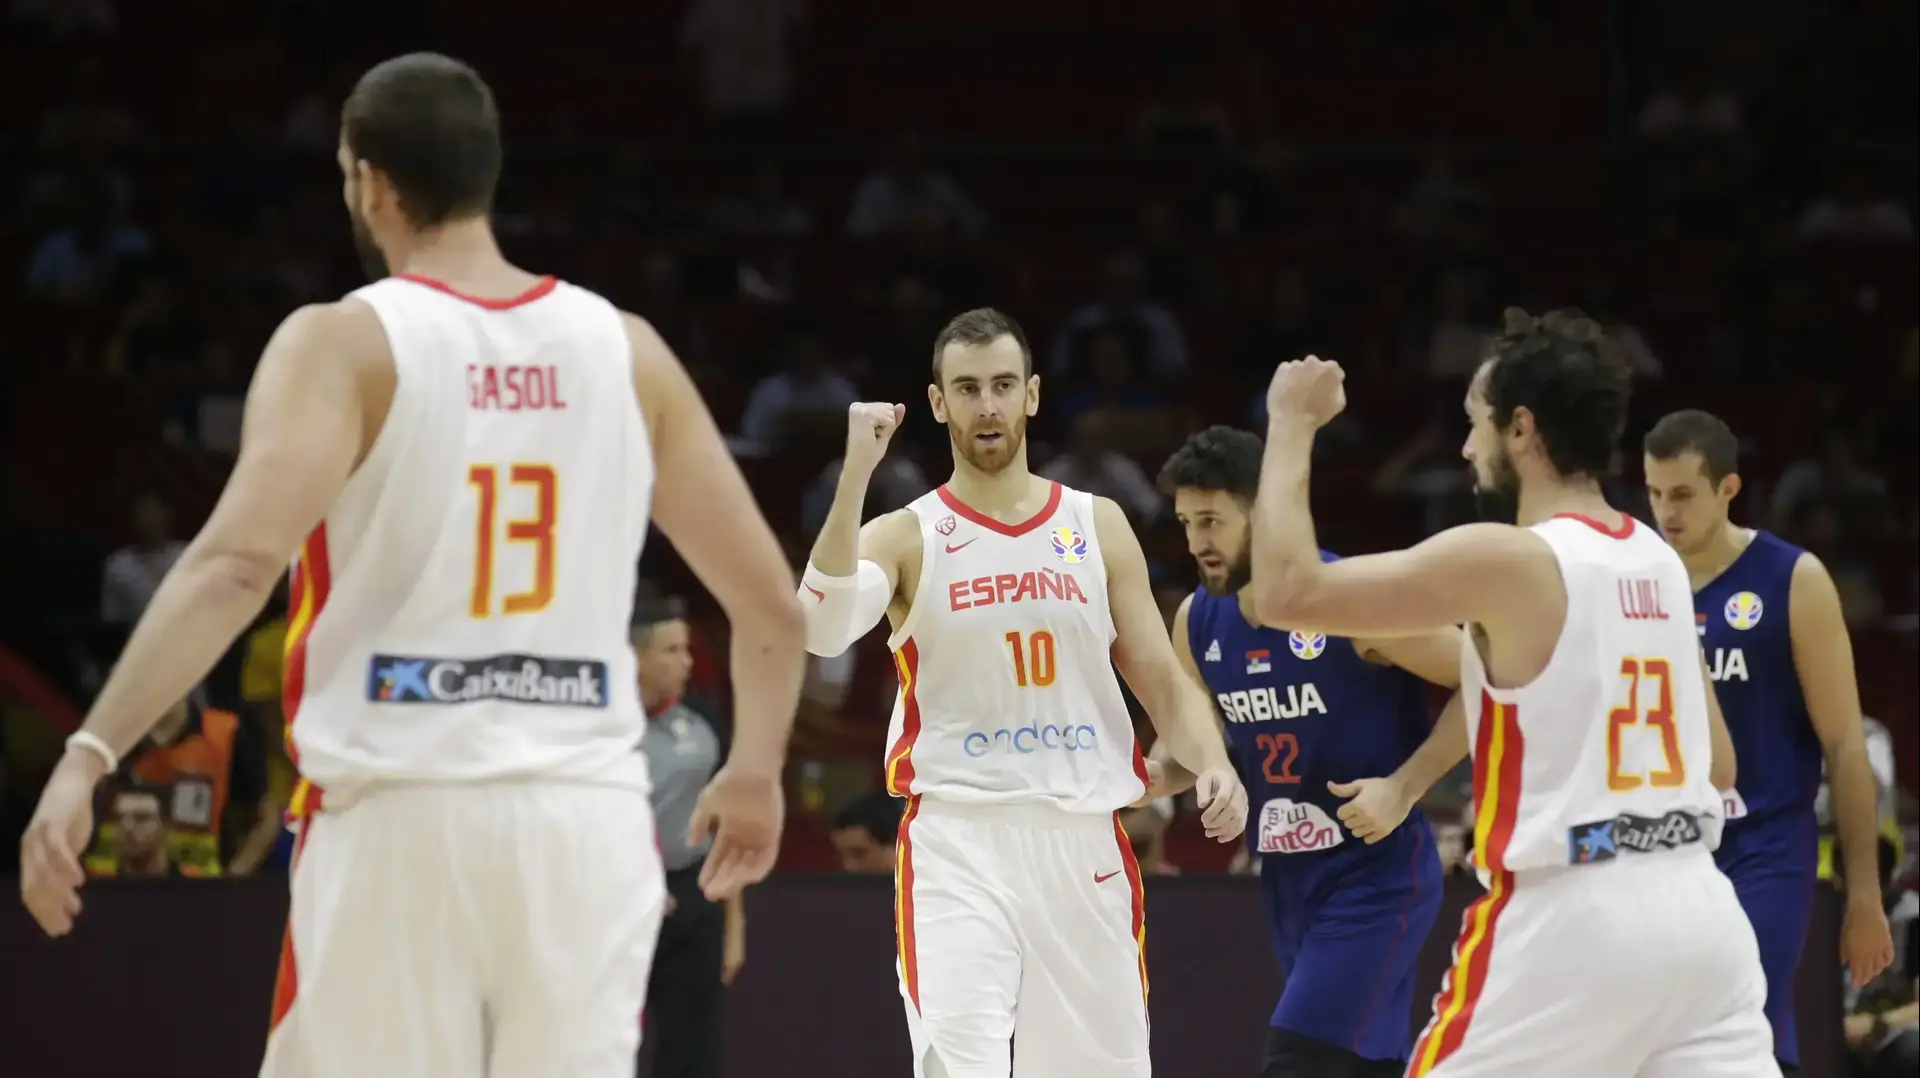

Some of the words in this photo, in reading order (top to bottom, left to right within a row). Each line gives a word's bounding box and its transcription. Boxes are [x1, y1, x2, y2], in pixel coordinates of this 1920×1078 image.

[466, 363, 567, 410] GASOL
[467, 462, 559, 619] 13
[949, 567, 1088, 611] ESPAÑA
[427, 659, 602, 705] CaixaBank
[1005, 629, 1056, 687] 10
[1217, 682, 1328, 723] SRBIJA
[1606, 656, 1686, 793] 23
[1255, 733, 1300, 783] 22
